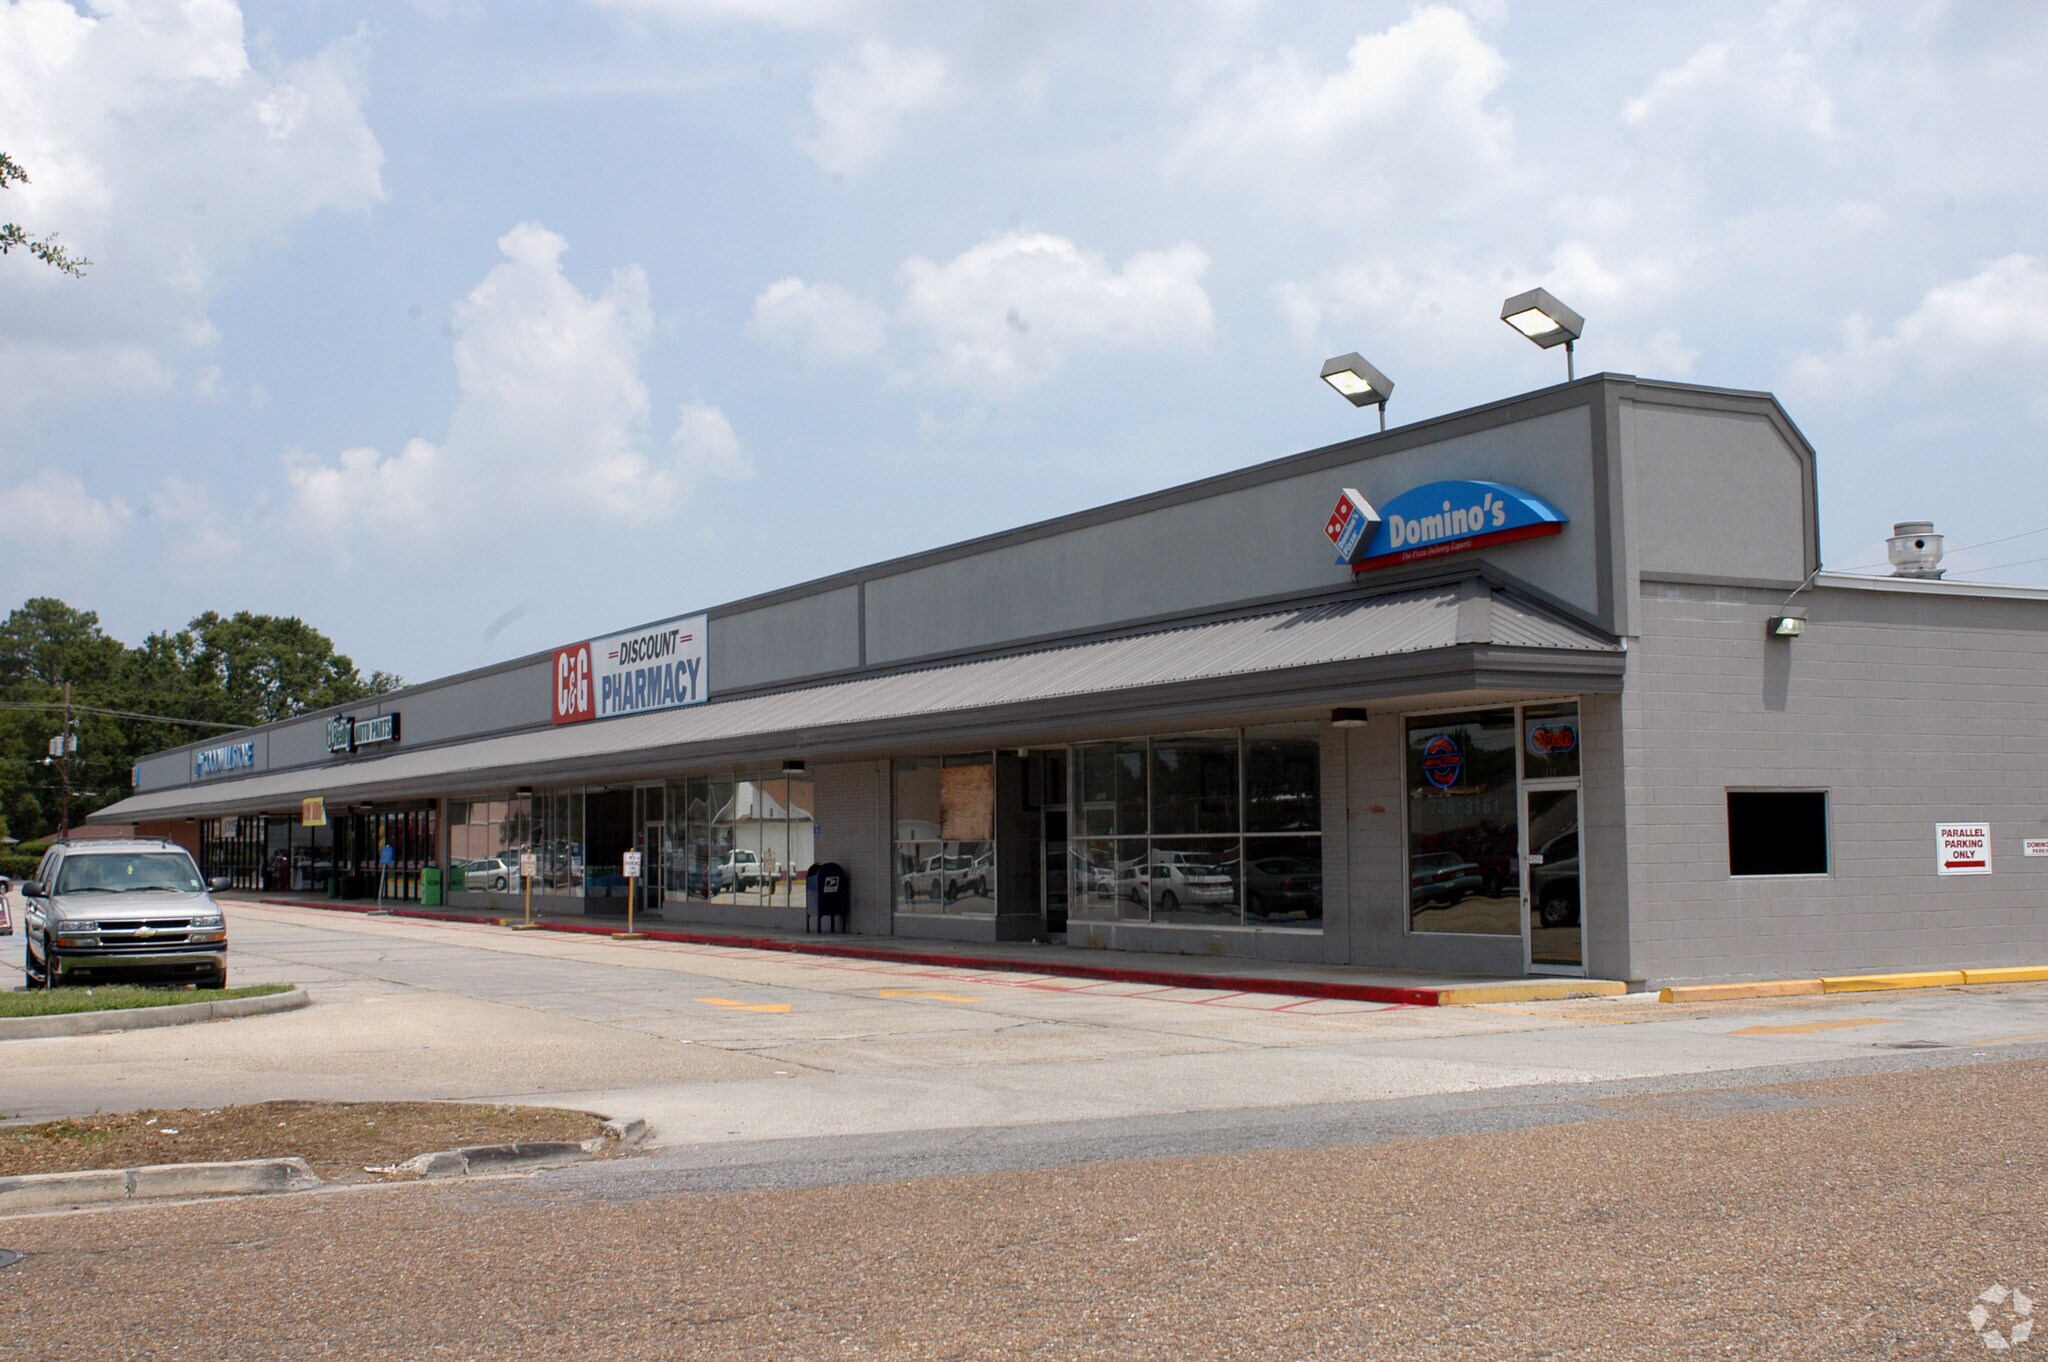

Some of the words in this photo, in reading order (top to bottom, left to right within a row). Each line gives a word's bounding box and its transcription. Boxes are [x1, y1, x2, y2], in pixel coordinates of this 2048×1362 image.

[1389, 493, 1506, 549] Domino's
[1412, 549, 1427, 558] Pizza
[1428, 544, 1450, 555] Delivery
[619, 629, 680, 666] DISCOUNT
[558, 648, 588, 716] C&G
[602, 656, 701, 714] PHARMACY
[371, 717, 391, 740] PARTS
[1941, 829, 1985, 837] PARALLEL
[1945, 840, 1983, 848] PARKING
[1952, 850, 1975, 859] ONLY
